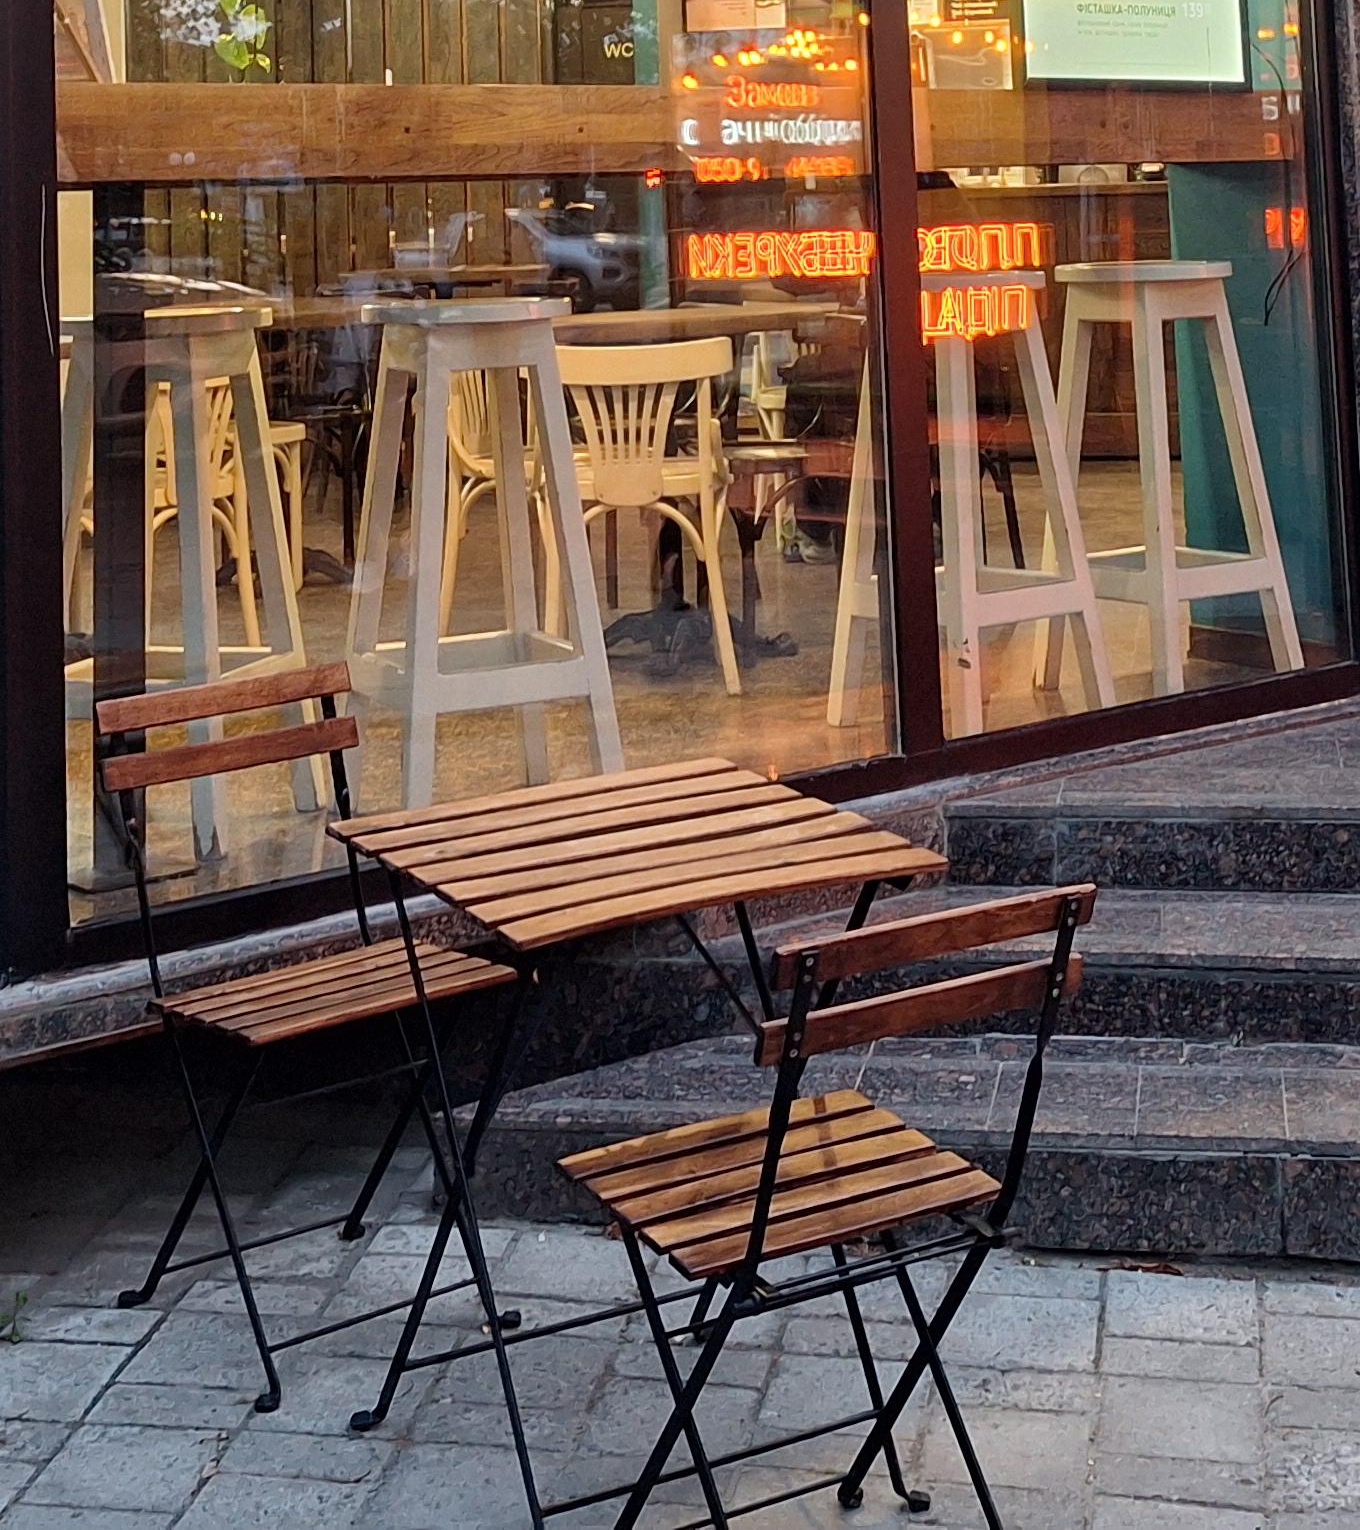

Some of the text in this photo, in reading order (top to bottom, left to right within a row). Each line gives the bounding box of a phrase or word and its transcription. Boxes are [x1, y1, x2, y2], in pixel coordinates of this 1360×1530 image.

[1076, 2, 1204, 18] ФІСТАШКА-ПОЛУНИЦЯ 139
[603, 42, 634, 59] WC
